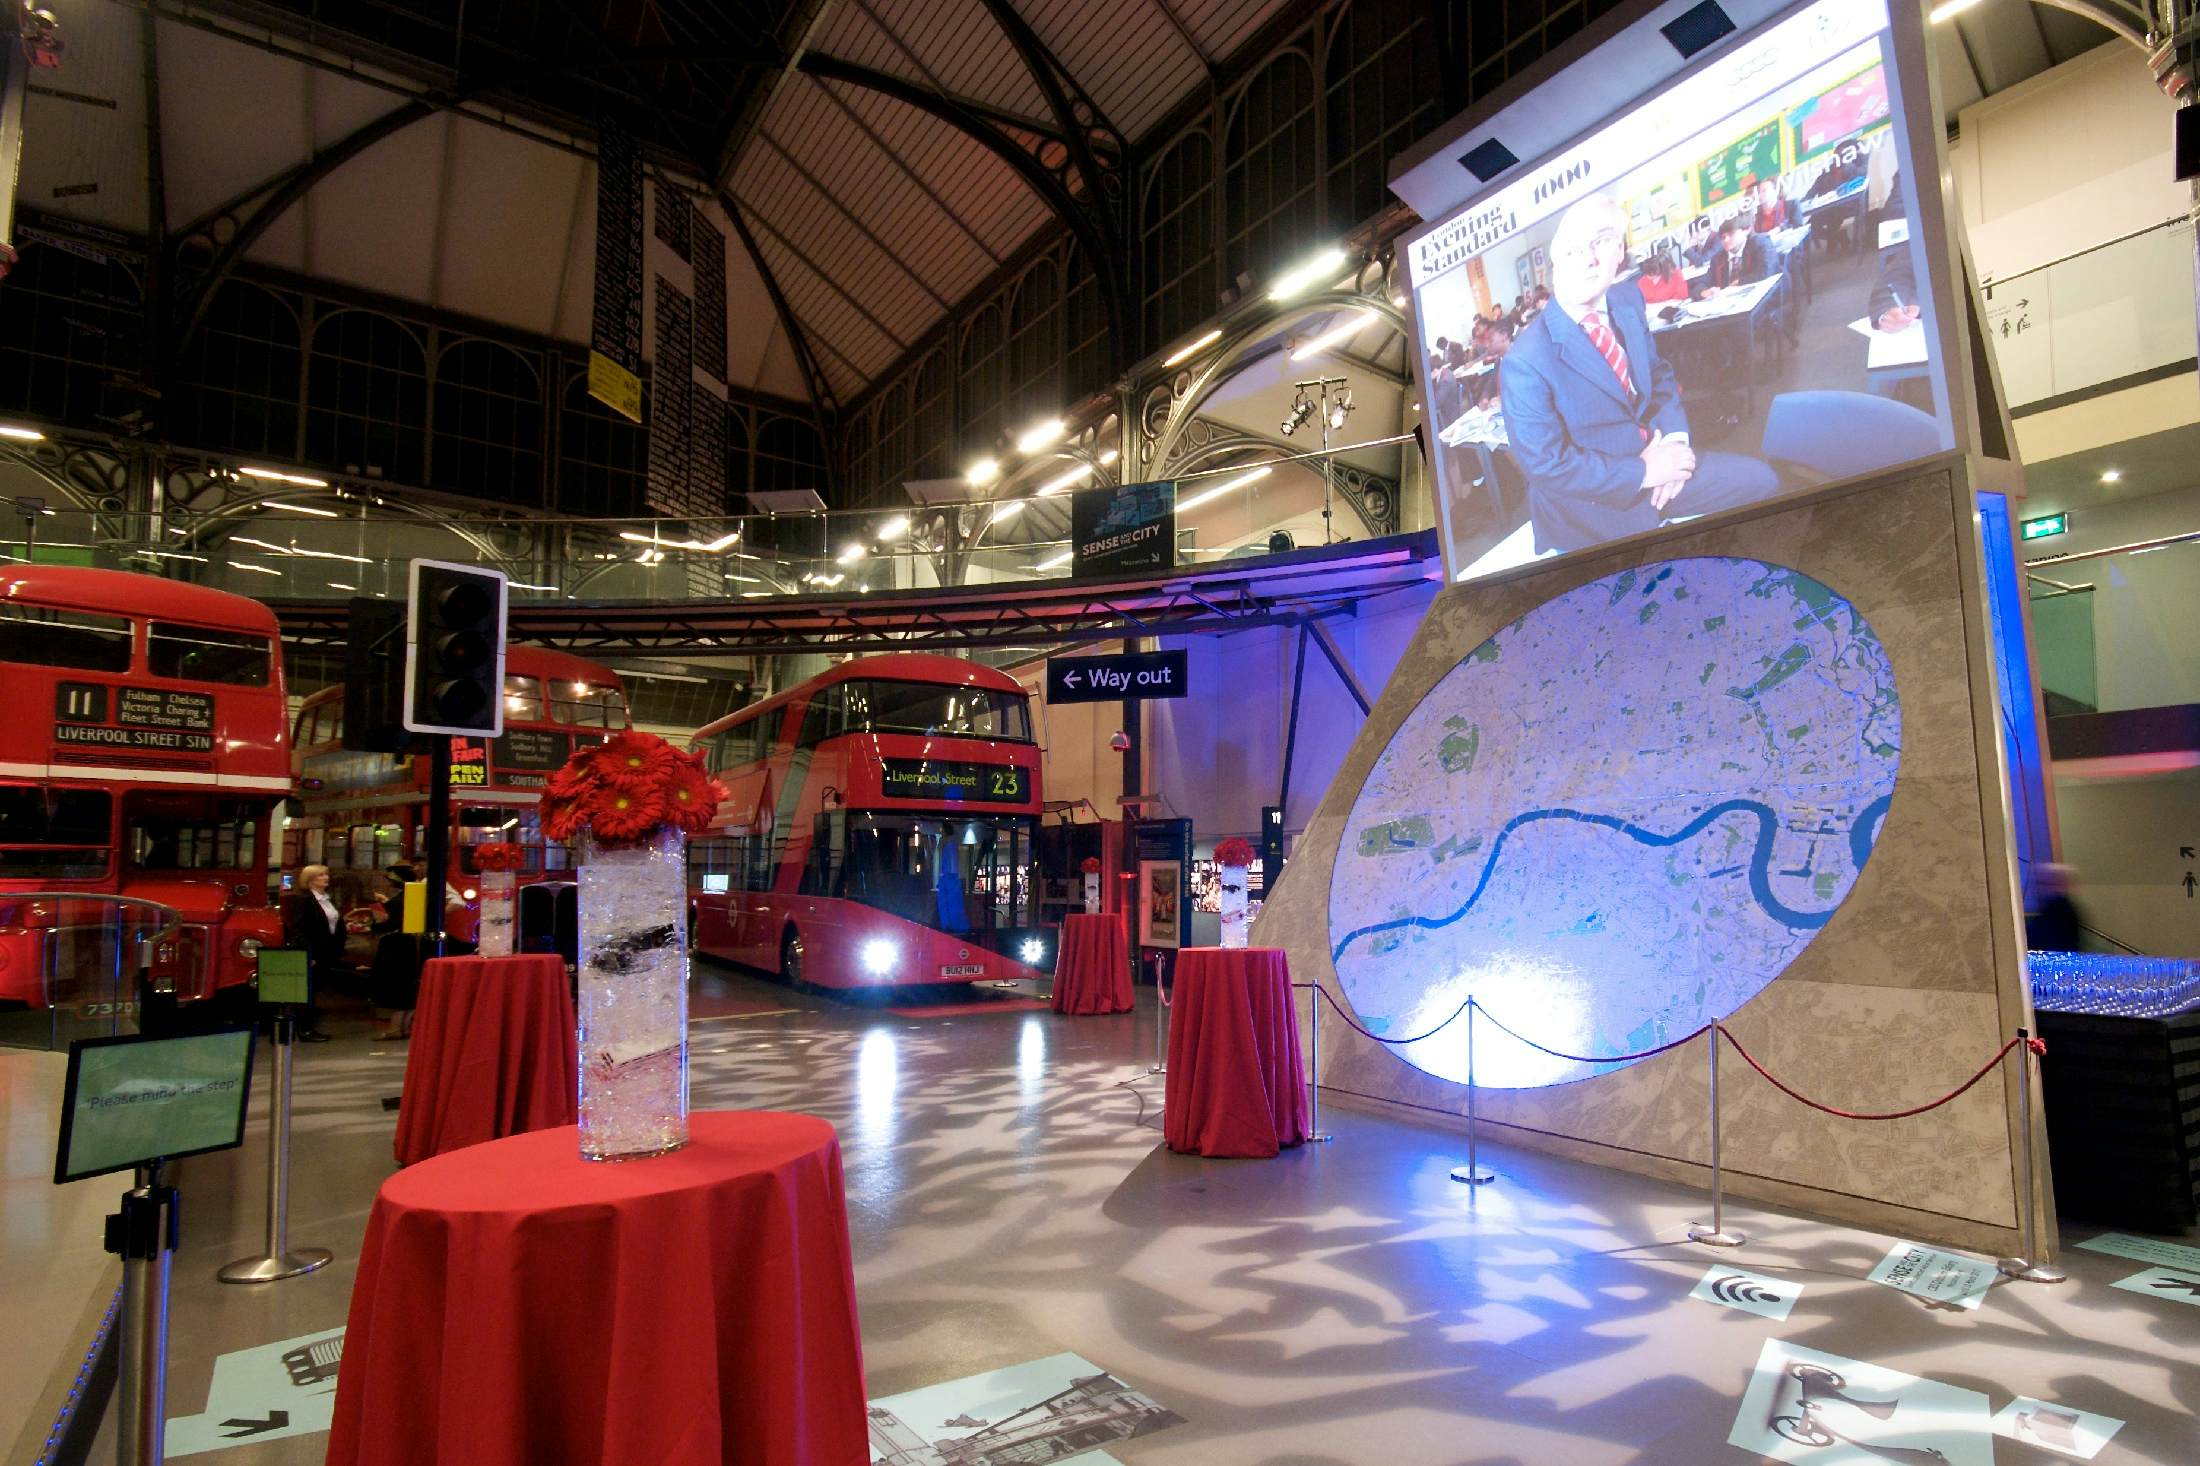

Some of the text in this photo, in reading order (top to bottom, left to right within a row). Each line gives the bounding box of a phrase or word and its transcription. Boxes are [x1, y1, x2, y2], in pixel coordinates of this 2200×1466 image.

[1534, 160, 1590, 204] 1000
[1420, 204, 1503, 262] Evening
[1422, 210, 1518, 279] Standard
[1082, 536, 1119, 556] SENSE
[1132, 524, 1160, 541] CITY
[1088, 666, 1172, 692] Way out
[68, 690, 92, 715] 11
[122, 700, 160, 714] Victoria
[166, 704, 200, 719] Charing
[126, 690, 206, 706] Fulham Chelsea
[122, 711, 209, 729] Fleet Street Bank
[57, 726, 210, 750] LIVERPOOL STREET STN
[450, 764, 484, 775] PEN
[450, 774, 484, 784] AILY
[892, 769, 1018, 795] Liverpool Street 23
[1272, 811, 1281, 824] 11
[142, 1086, 177, 1102] mind
[181, 1083, 204, 1097] the
